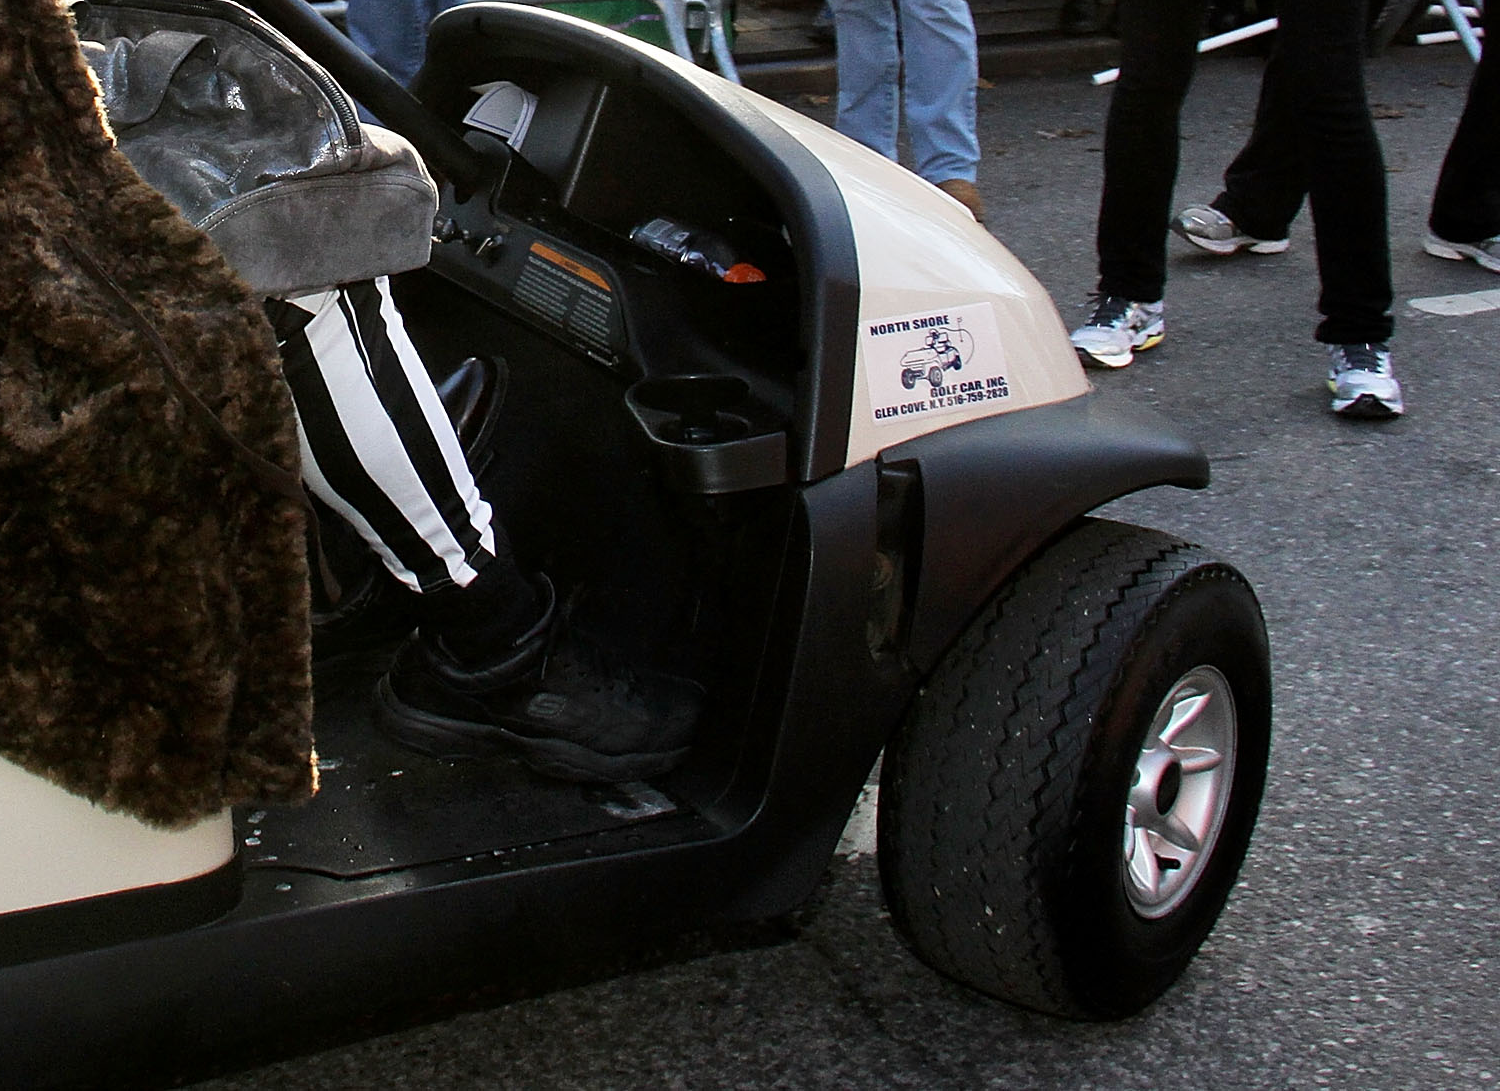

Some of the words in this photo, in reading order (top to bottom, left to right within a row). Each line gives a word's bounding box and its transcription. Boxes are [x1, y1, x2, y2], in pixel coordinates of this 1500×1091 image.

[870, 320, 910, 336] NORTH
[913, 315, 950, 330] SHORE
[930, 384, 958, 398] GOLF
[986, 376, 1008, 388] INC.
[875, 406, 898, 419] GLEN
[947, 387, 1009, 407] 516-759-2828
